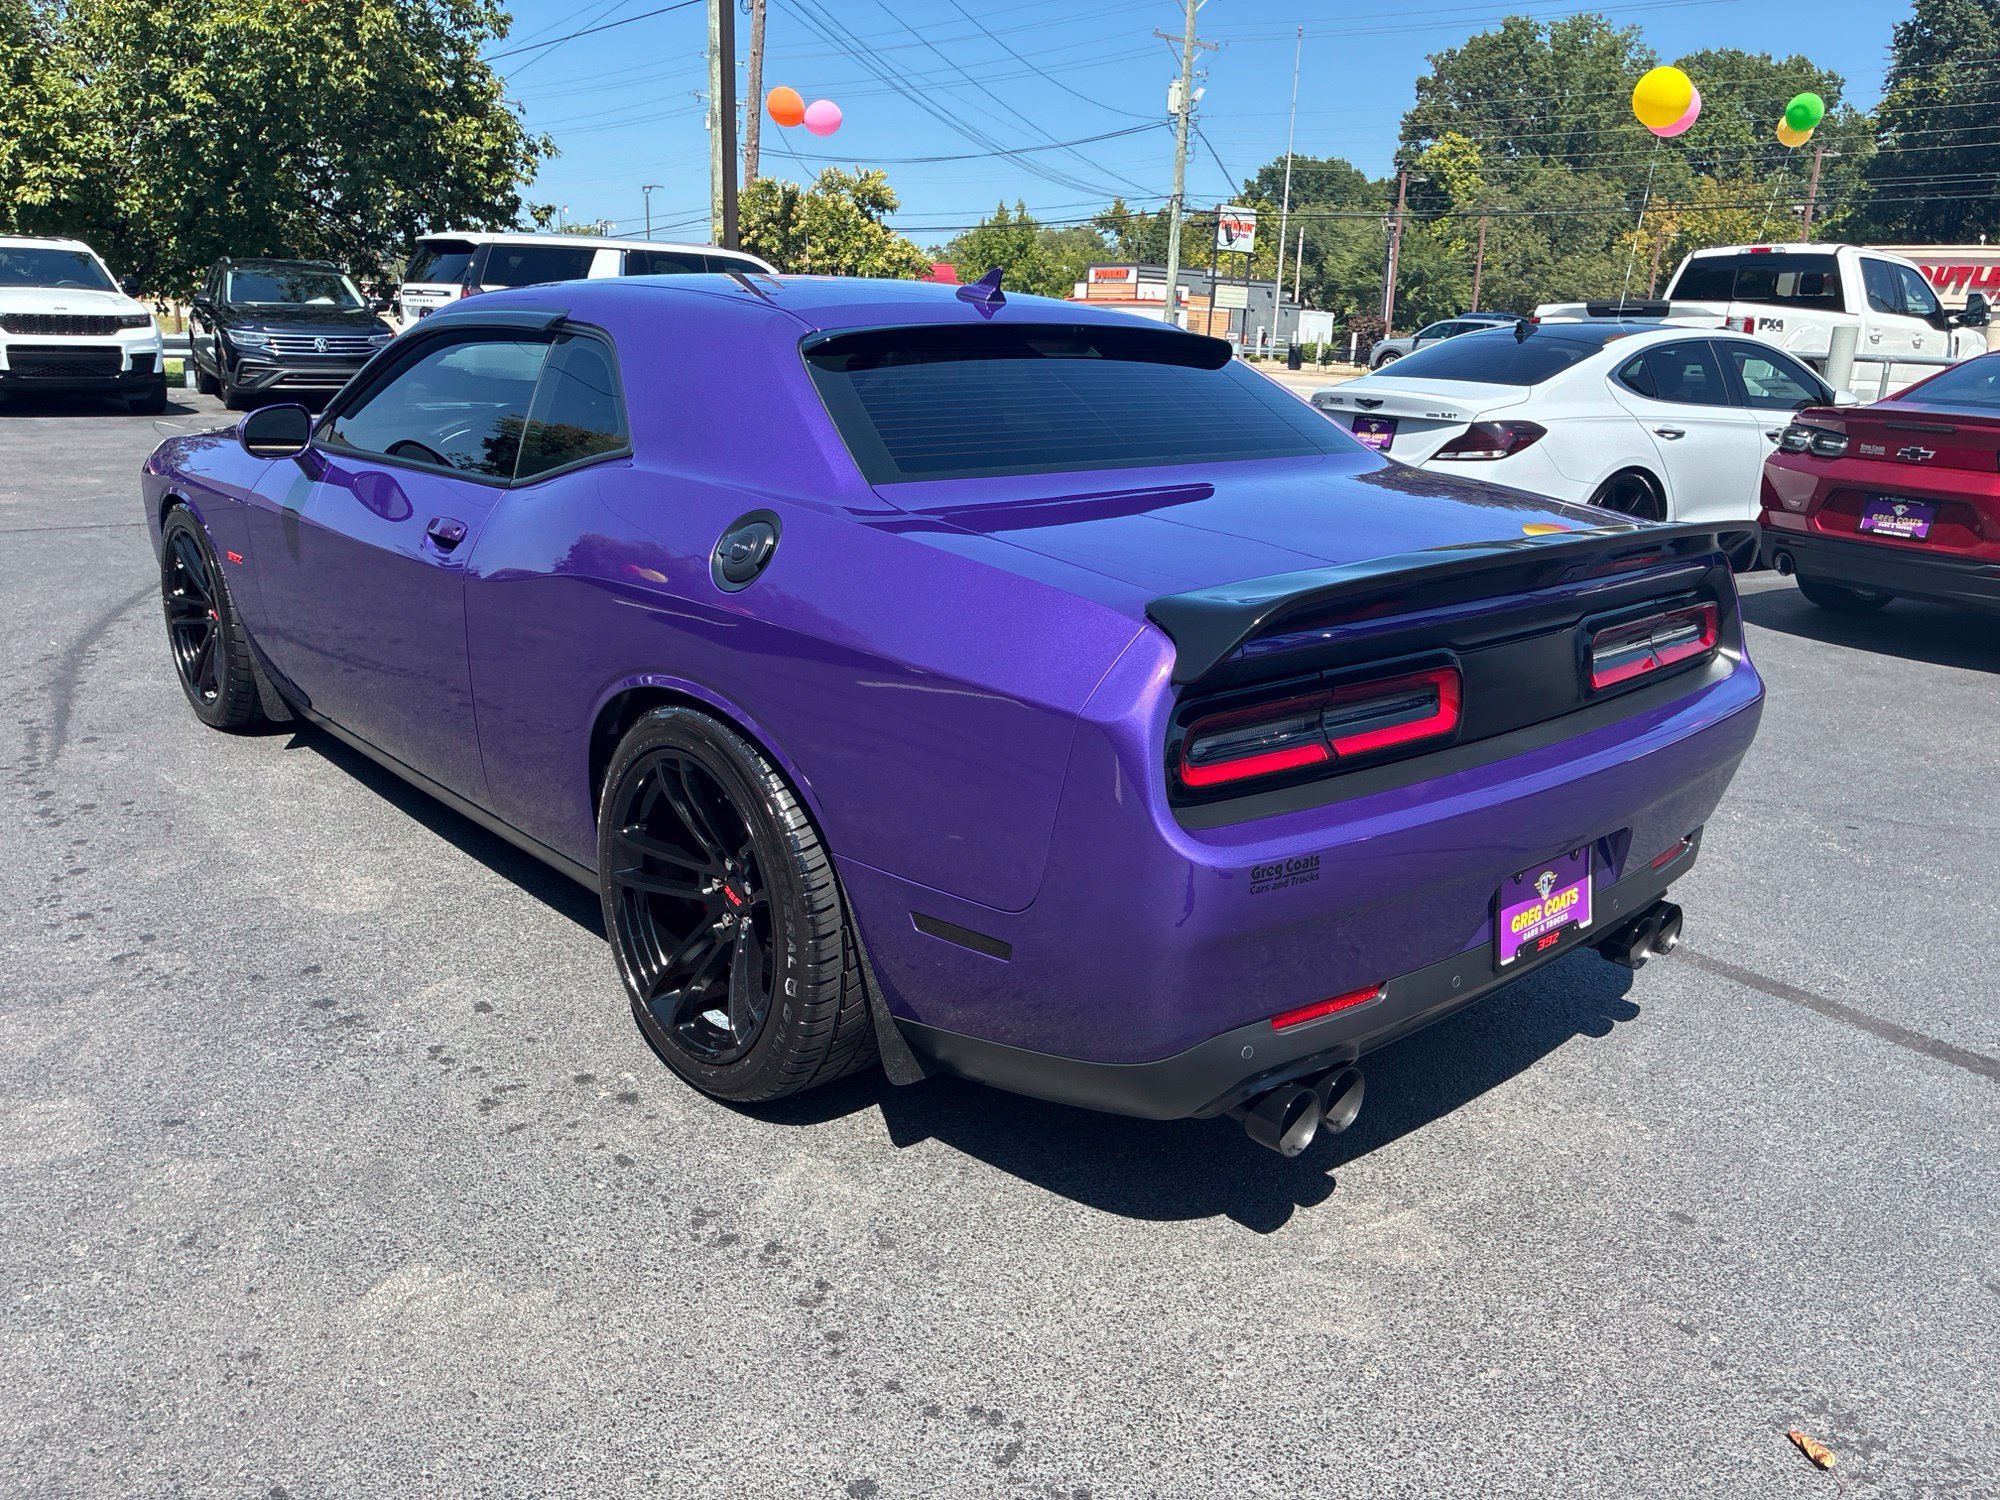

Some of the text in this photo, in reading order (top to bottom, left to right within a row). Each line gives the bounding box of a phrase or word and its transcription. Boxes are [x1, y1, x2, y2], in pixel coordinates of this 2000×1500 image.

[1758, 317, 1784, 331] FX4
[1872, 513, 1924, 528] GREG COATS
[1251, 855, 1320, 880] Greg Coats
[1250, 872, 1320, 895] Cars and Trucks
[1511, 887, 1579, 933] GREG COATS
[1523, 926, 1539, 941] CARS
[1547, 912, 1569, 929] TRUCKS
[1537, 931, 1560, 952] 392
